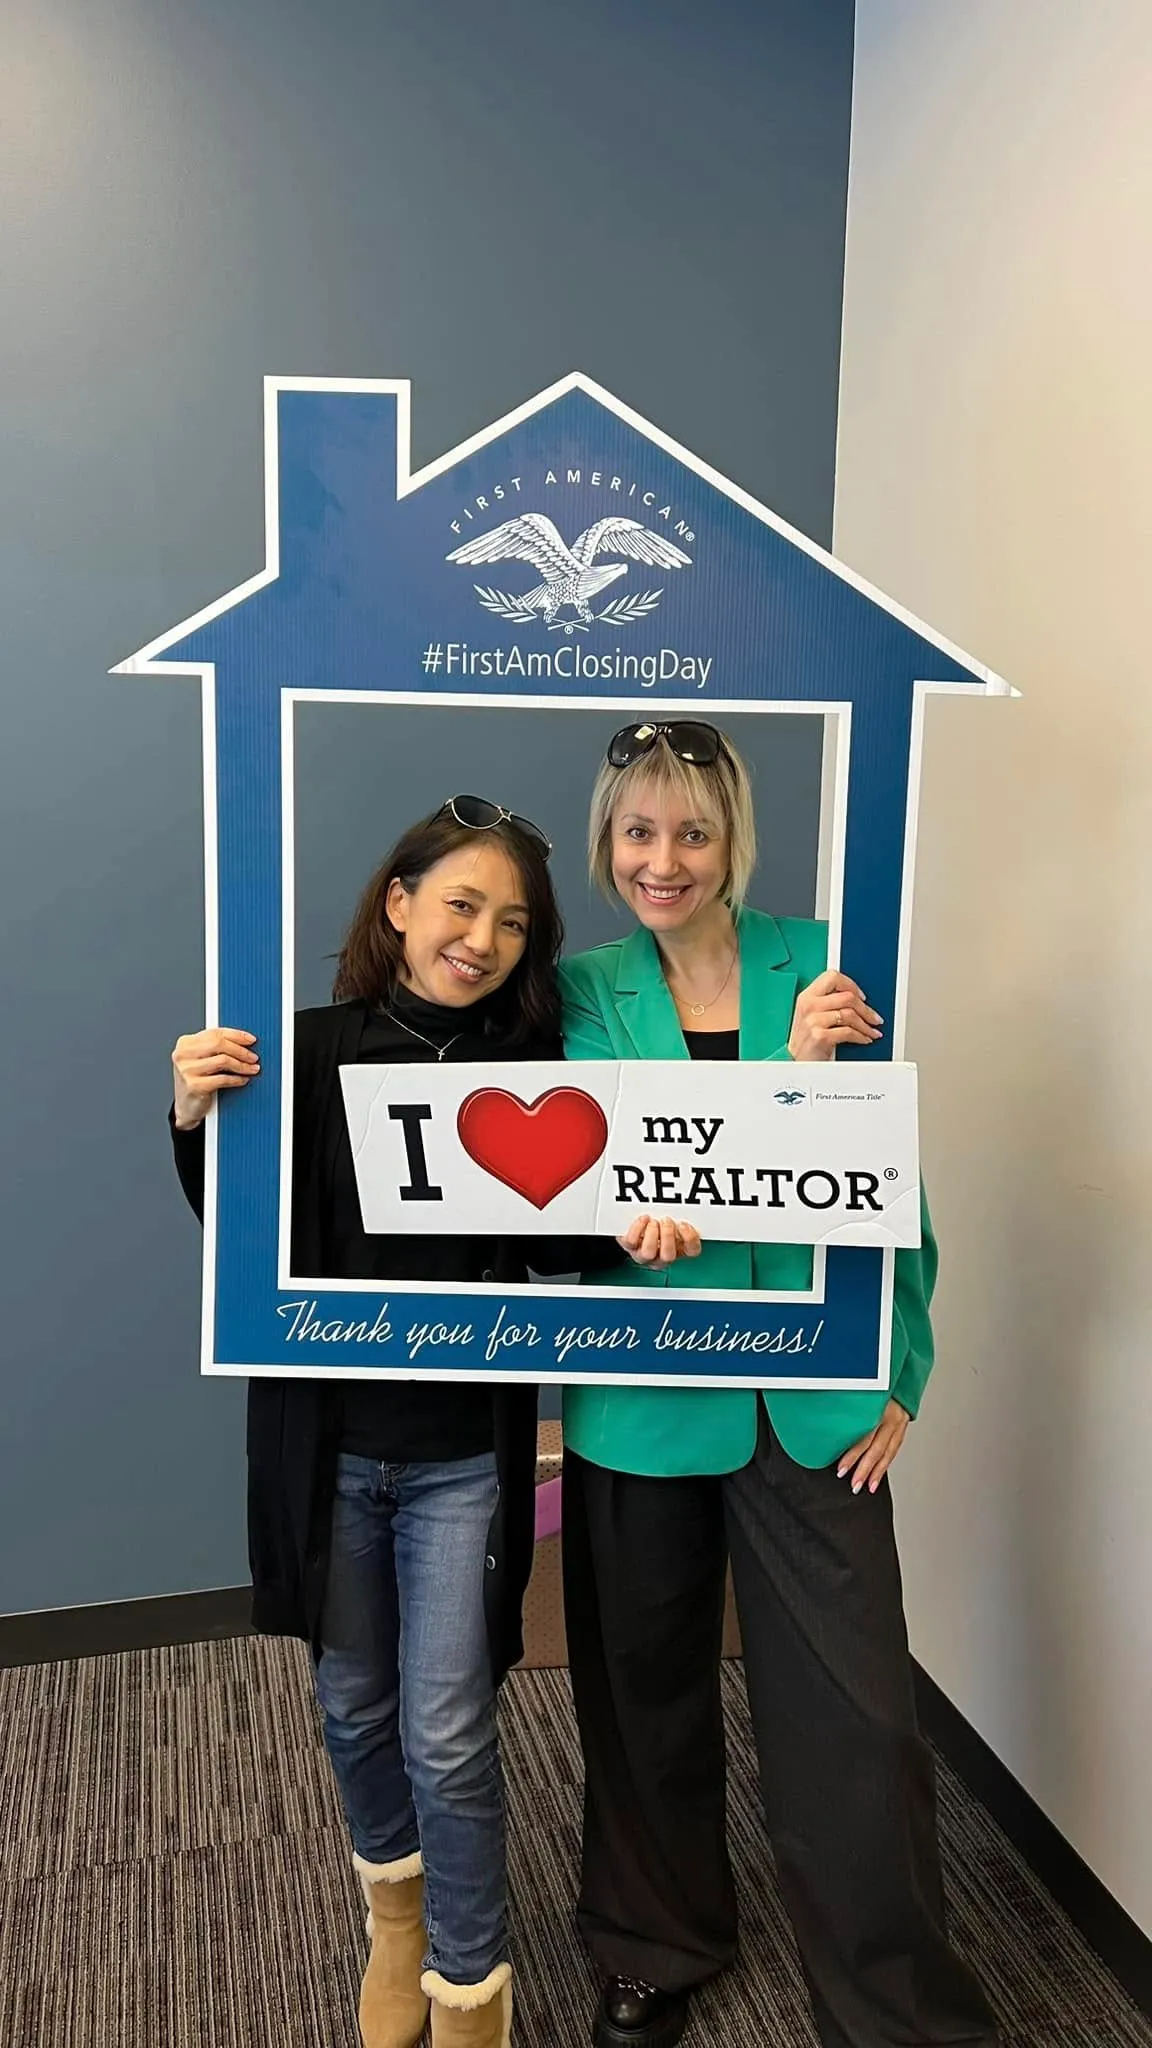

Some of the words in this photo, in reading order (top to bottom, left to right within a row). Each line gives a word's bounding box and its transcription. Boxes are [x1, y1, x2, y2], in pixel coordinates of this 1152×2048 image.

[450, 477, 522, 534] FIRST
[422, 643, 713, 689] #FirstAmClosingDay
[815, 1092, 832, 1100] First
[832, 1092, 865, 1101] American
[388, 1103, 443, 1202] I
[643, 1116, 724, 1154] my
[277, 1300, 394, 1346] Thank
[405, 1319, 474, 1360] you
[484, 1304, 542, 1361] for
[553, 1325, 641, 1363] your
[653, 1310, 825, 1356] business!
